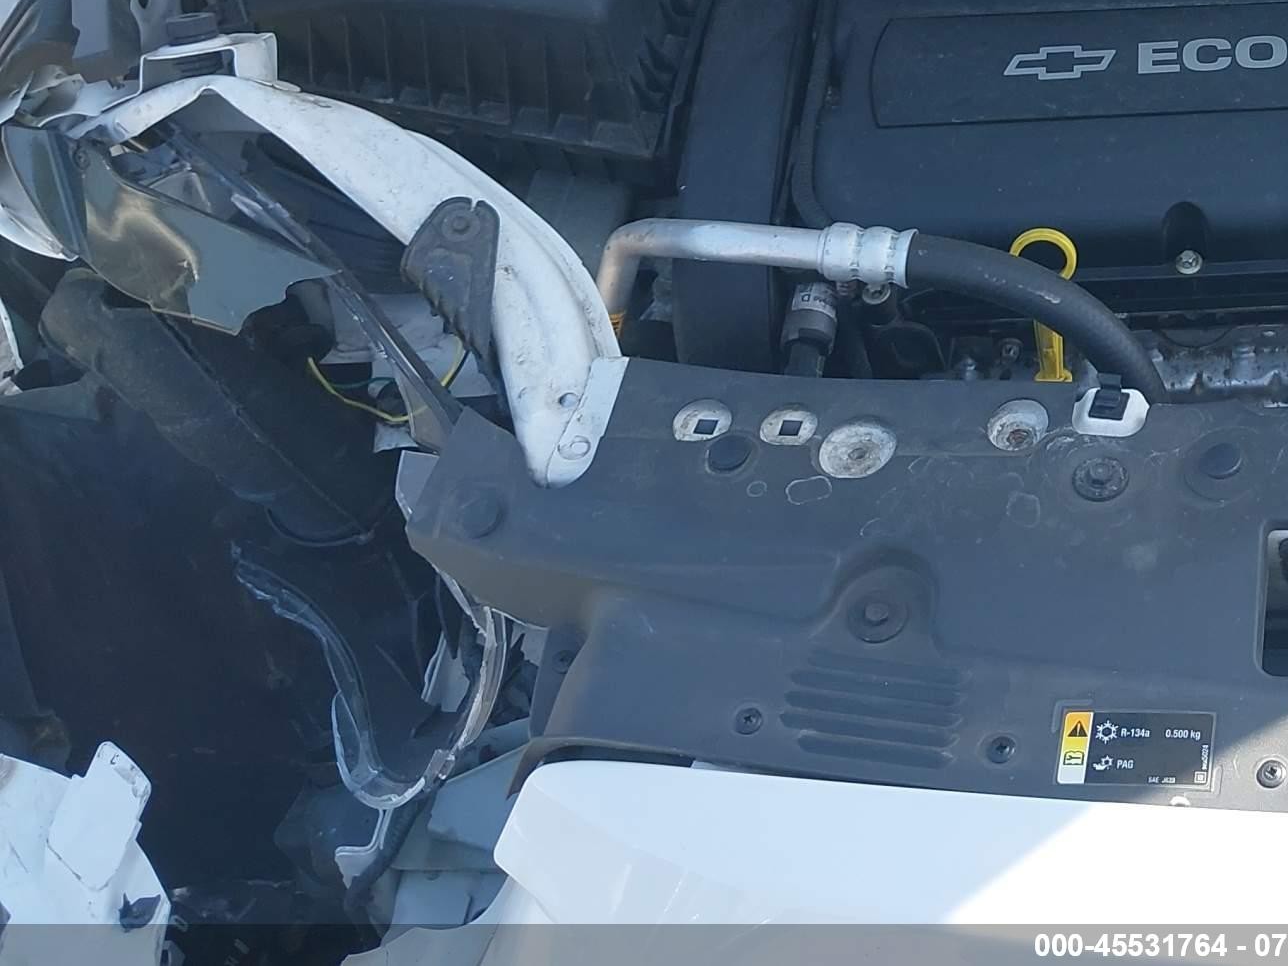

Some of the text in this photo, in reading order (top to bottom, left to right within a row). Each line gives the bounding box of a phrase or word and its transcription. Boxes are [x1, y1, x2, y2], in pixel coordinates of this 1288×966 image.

[1120, 728, 1201, 741] R-134a 0.500 kg
[1117, 760, 1134, 769] PAG
